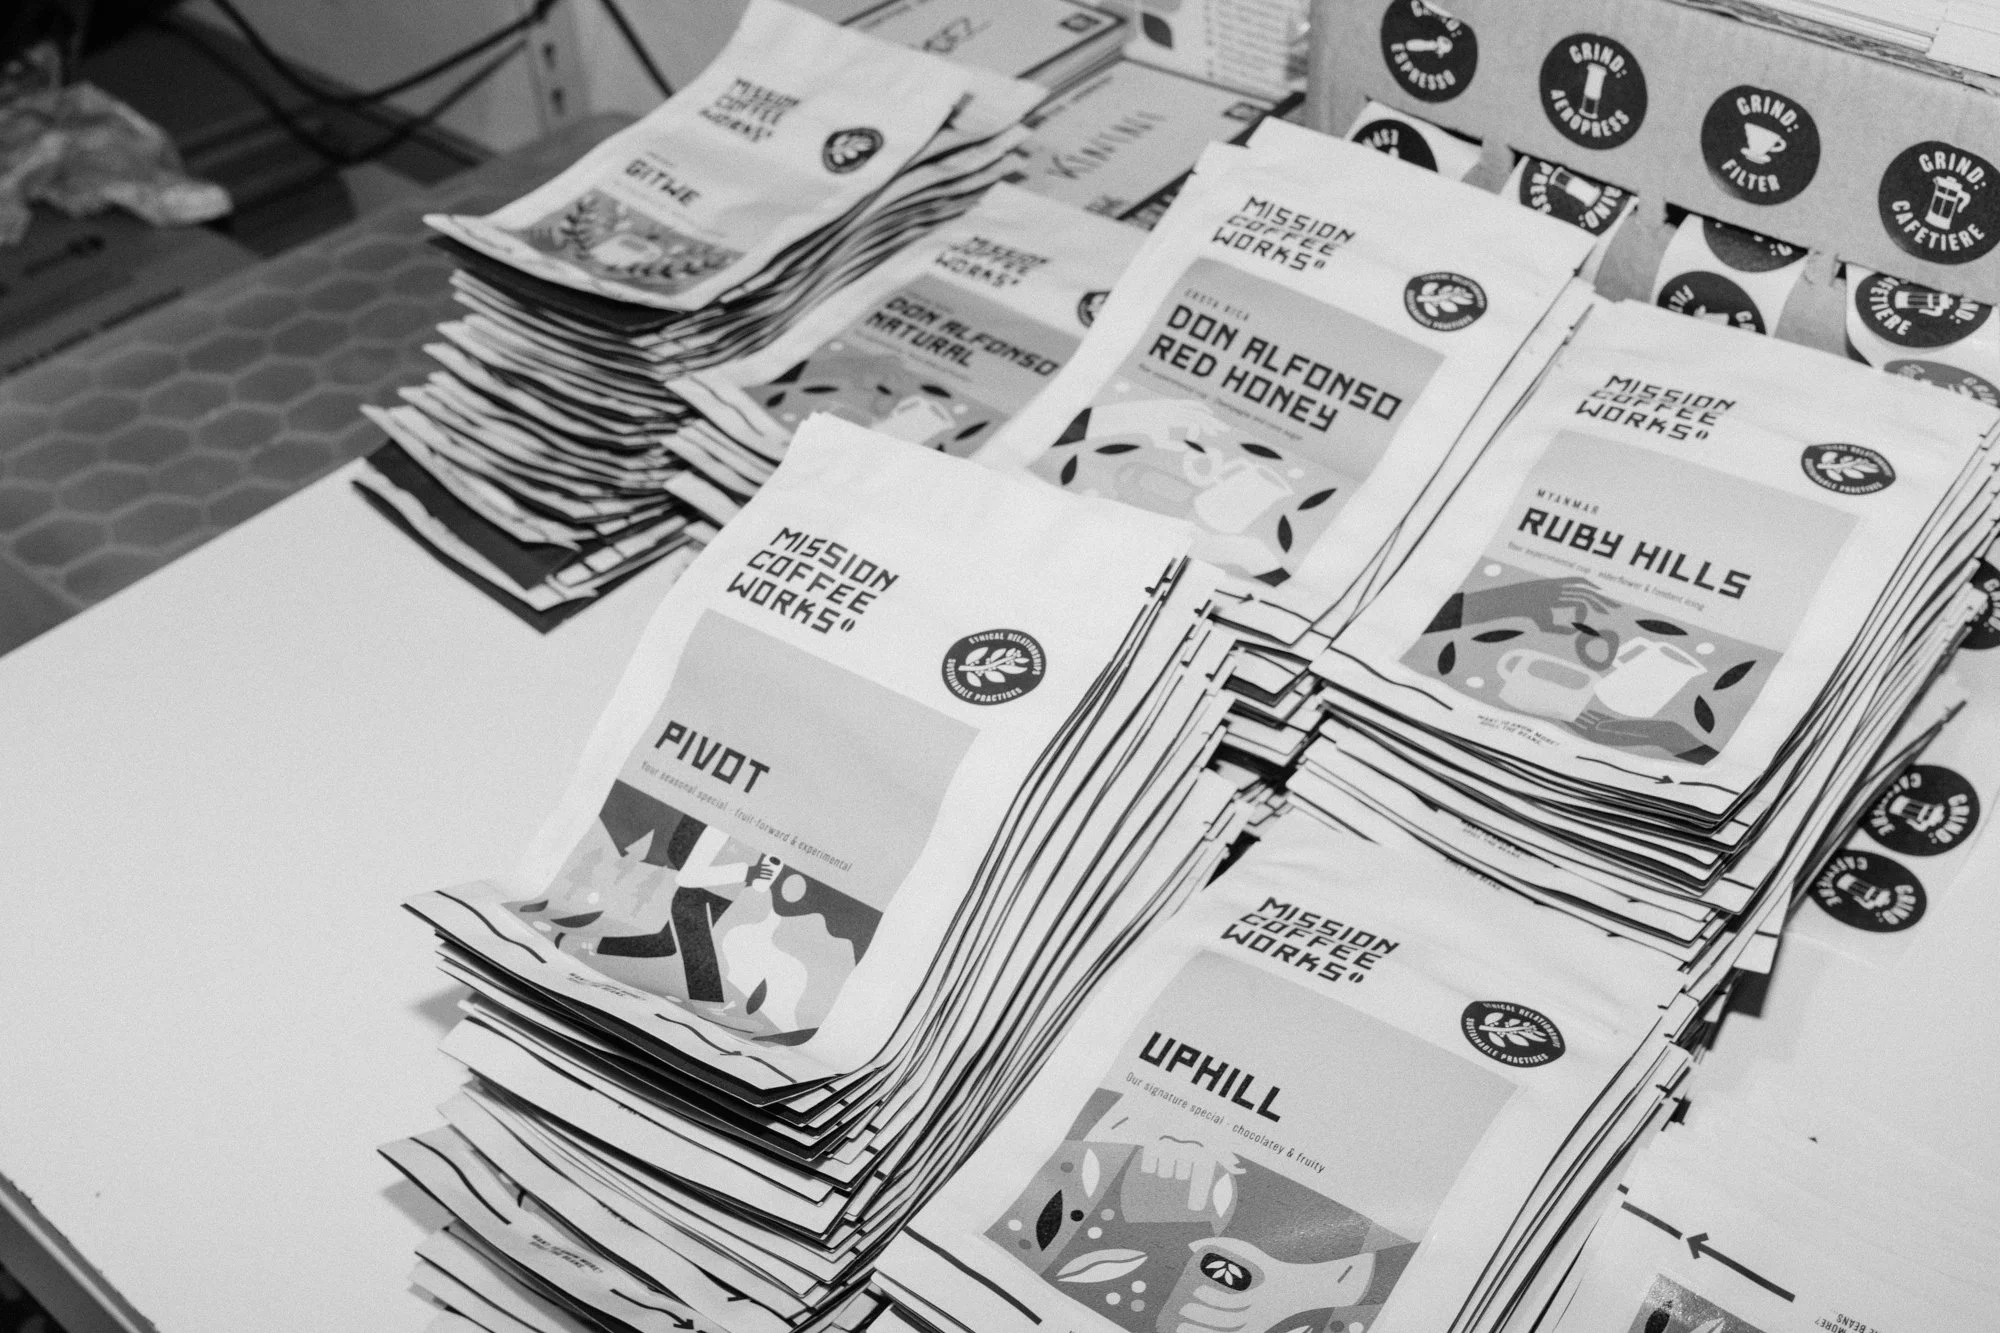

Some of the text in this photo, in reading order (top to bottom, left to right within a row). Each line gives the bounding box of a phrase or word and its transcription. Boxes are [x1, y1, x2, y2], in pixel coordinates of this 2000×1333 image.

[1391, 43, 1456, 91] ESPRESSO
[1569, 42, 1628, 79] GRIND:
[1551, 89, 1630, 138] AEROPRESS
[1736, 95, 1799, 133] GRIND:
[625, 158, 700, 206] GITWE
[1721, 158, 1781, 193] FILTER
[1918, 151, 1987, 190] GRIND:
[1227, 214, 1342, 257] COFFEE
[1241, 196, 1356, 243] MISSION
[1891, 199, 1986, 251] CAFETIERE
[865, 310, 973, 368] NATURAL
[885, 296, 942, 325] DON
[940, 319, 1061, 377] ALFONSO
[1148, 333, 1218, 378] RED
[1221, 365, 1338, 433] HONEY
[1167, 303, 1239, 351] DON
[1241, 336, 1402, 421] ALFONSO
[1590, 390, 1723, 426] COFFEE
[1604, 375, 1737, 410] MISSION
[770, 527, 899, 592] MISSION
[1517, 507, 1752, 600] RUBY HILLS
[747, 550, 877, 615] COFFEE
[654, 720, 770, 794] PIVOT
[1927, 793, 1970, 844] GRIND:
[798, 841, 853, 872] experimental
[1257, 896, 1400, 955] MISSION
[1875, 884, 1916, 925] GRIND:
[1239, 913, 1382, 970] COFFEE
[1139, 1031, 1280, 1123] UPHILL
[1500, 1053, 1549, 1065] PRACTISES
[1126, 1071, 1326, 1174] Our signature special chocolatey & fruity
